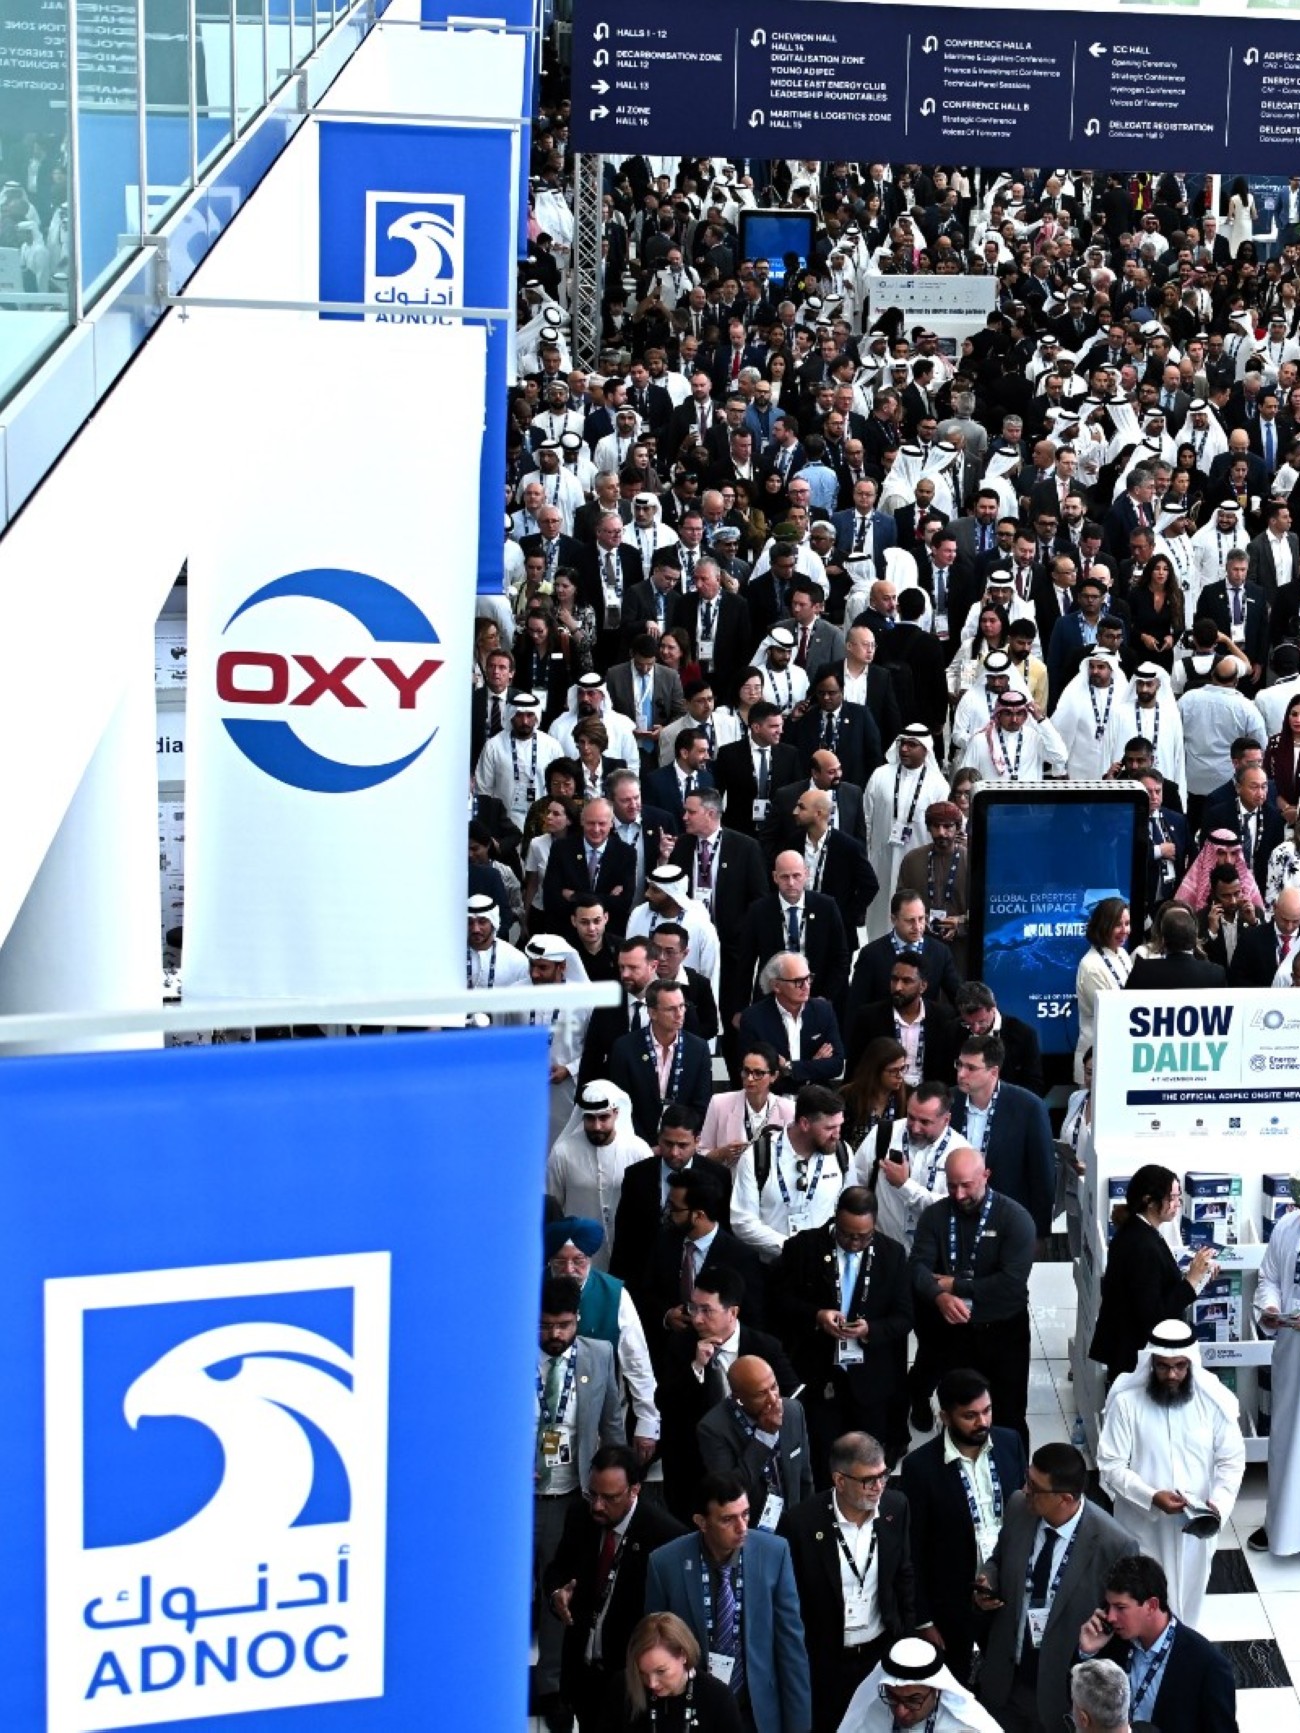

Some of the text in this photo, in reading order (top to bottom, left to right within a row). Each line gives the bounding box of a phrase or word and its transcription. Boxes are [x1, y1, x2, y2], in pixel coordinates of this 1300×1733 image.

[617, 29, 644, 37] HALLS
[772, 32, 837, 43] CHEVRON HALL
[772, 43, 793, 51] HALL
[944, 39, 1002, 49] CONFERENCE
[1003, 41, 1024, 49] HALL
[1129, 46, 1150, 54] HALL
[616, 51, 697, 60] DECARBONISATION
[771, 54, 865, 64] DIGITALISATION ZONE
[1015, 55, 1056, 64] Conference
[1264, 52, 1294, 61] ADIPEC
[804, 68, 835, 76] ADIPEC
[1019, 69, 1060, 77] Conference
[1144, 73, 1185, 82] Conference
[1263, 77, 1295, 85] ENERGY
[616, 81, 638, 89] HALL
[827, 81, 861, 89] ENERGY
[1000, 82, 1031, 90] Sessions
[770, 90, 888, 101] LEADERSHIP ROUNDTABLES
[627, 106, 651, 114] ZONE
[943, 100, 999, 110] CONFERENCE
[1001, 103, 1021, 111] HALL
[770, 110, 812, 119] MARITIME
[821, 111, 866, 120] LOGISTICS
[868, 113, 891, 121] ZONE
[616, 117, 637, 125] HALL
[1109, 121, 1214, 132] DELEGATE REGISTRATION
[1260, 125, 1300, 134] DELEGATE
[374, 286, 453, 306] أدنوك
[216, 650, 445, 710] OXY
[990, 893, 1078, 903] GLOBAL EXPERTISE
[990, 903, 1077, 914] LOCAL IMPACT
[1039, 923, 1053, 937] OIL
[1037, 1001, 1072, 1018] 534
[1129, 1005, 1234, 1037] SHOW
[1132, 1041, 1229, 1073] DAILY
[1269, 1055, 1297, 1065] Energy
[1162, 1093, 1178, 1101] THE
[1180, 1092, 1217, 1101] OFFICIAL
[1219, 1092, 1248, 1100] ADIPEC
[1251, 1091, 1281, 1099] ONSITE
[83, 1545, 351, 1635] أدنوك
[83, 1624, 351, 1701] ADNOC
